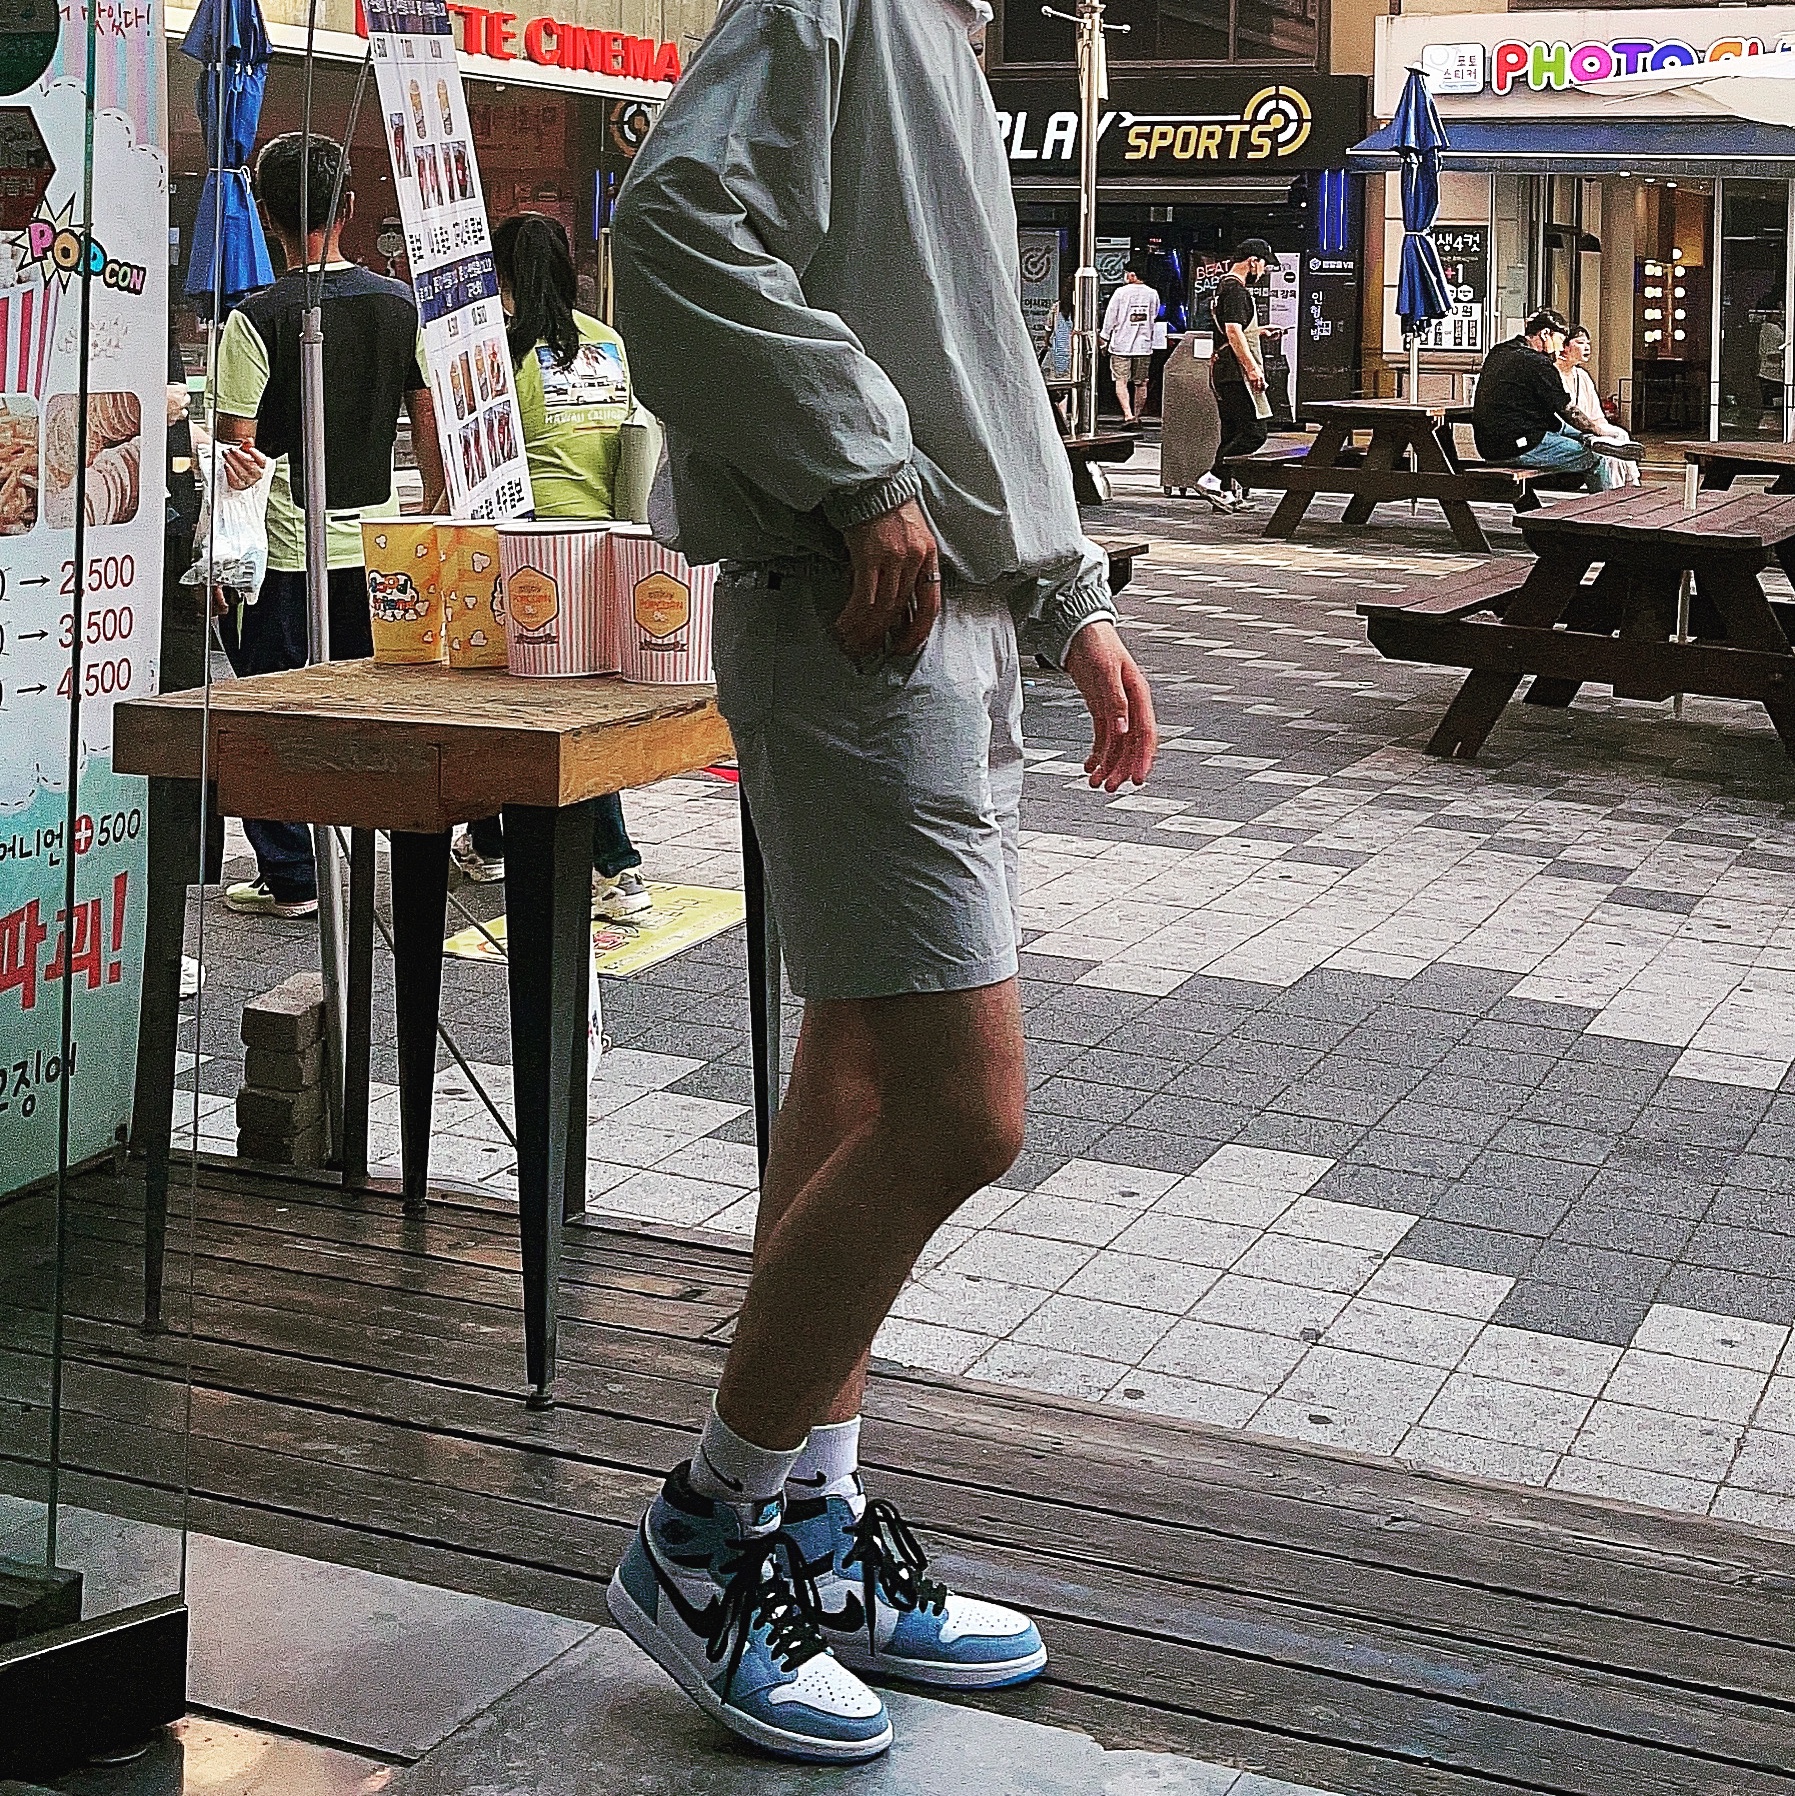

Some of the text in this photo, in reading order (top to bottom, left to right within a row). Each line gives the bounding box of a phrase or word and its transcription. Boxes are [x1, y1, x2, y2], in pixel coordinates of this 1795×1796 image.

[525, 17, 683, 83] CINEMA
[1457, 56, 1477, 66] 포토
[1493, 44, 1694, 91] PHOTO
[1443, 69, 1477, 80] 스티커
[1124, 124, 1275, 160] SPORTS
[104, 260, 146, 295] CON
[1196, 260, 1231, 280] BEAT
[59, 554, 135, 597] 2,500
[58, 607, 134, 650] 3,500
[56, 658, 132, 703] 4,500
[0, 820, 64, 867] 어니언
